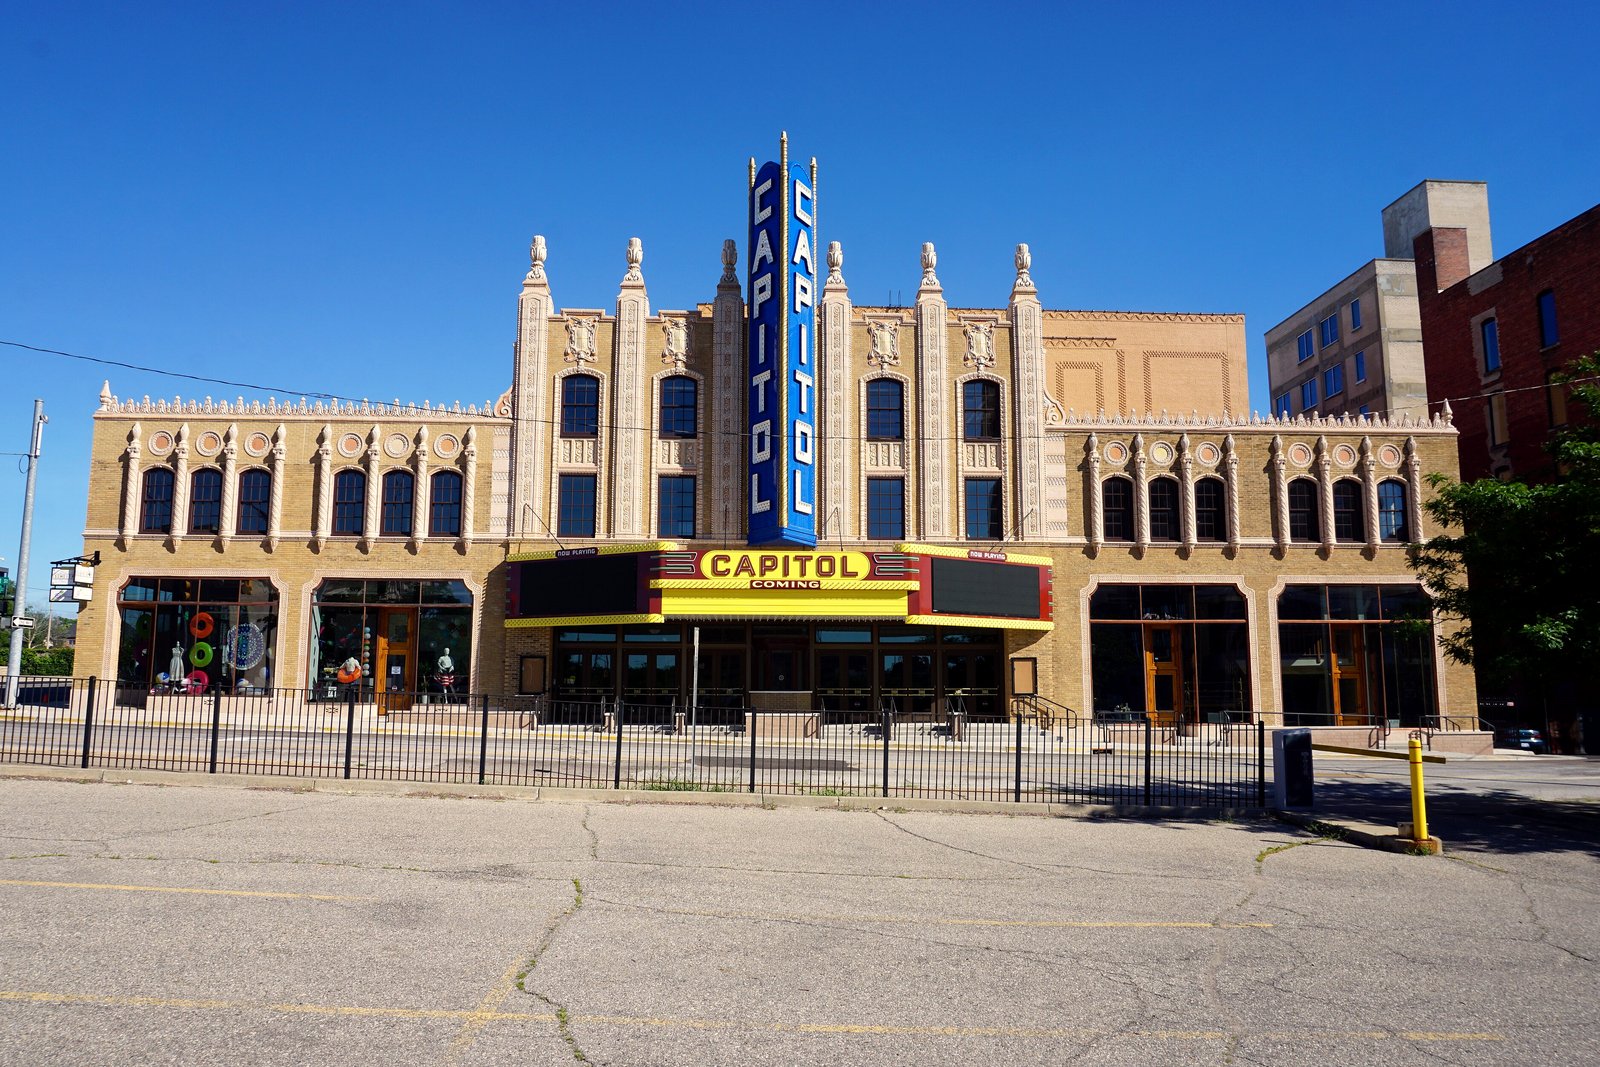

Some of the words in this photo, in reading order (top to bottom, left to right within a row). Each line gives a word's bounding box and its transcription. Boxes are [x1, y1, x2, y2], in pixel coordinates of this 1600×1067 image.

[752, 178, 774, 514] CAPITOL
[793, 178, 814, 515] CAPITOL
[572, 548, 595, 556] PLAYING
[984, 552, 1006, 560] PLAYING
[711, 555, 859, 578] CAPITOL
[752, 580, 820, 588] COMING
